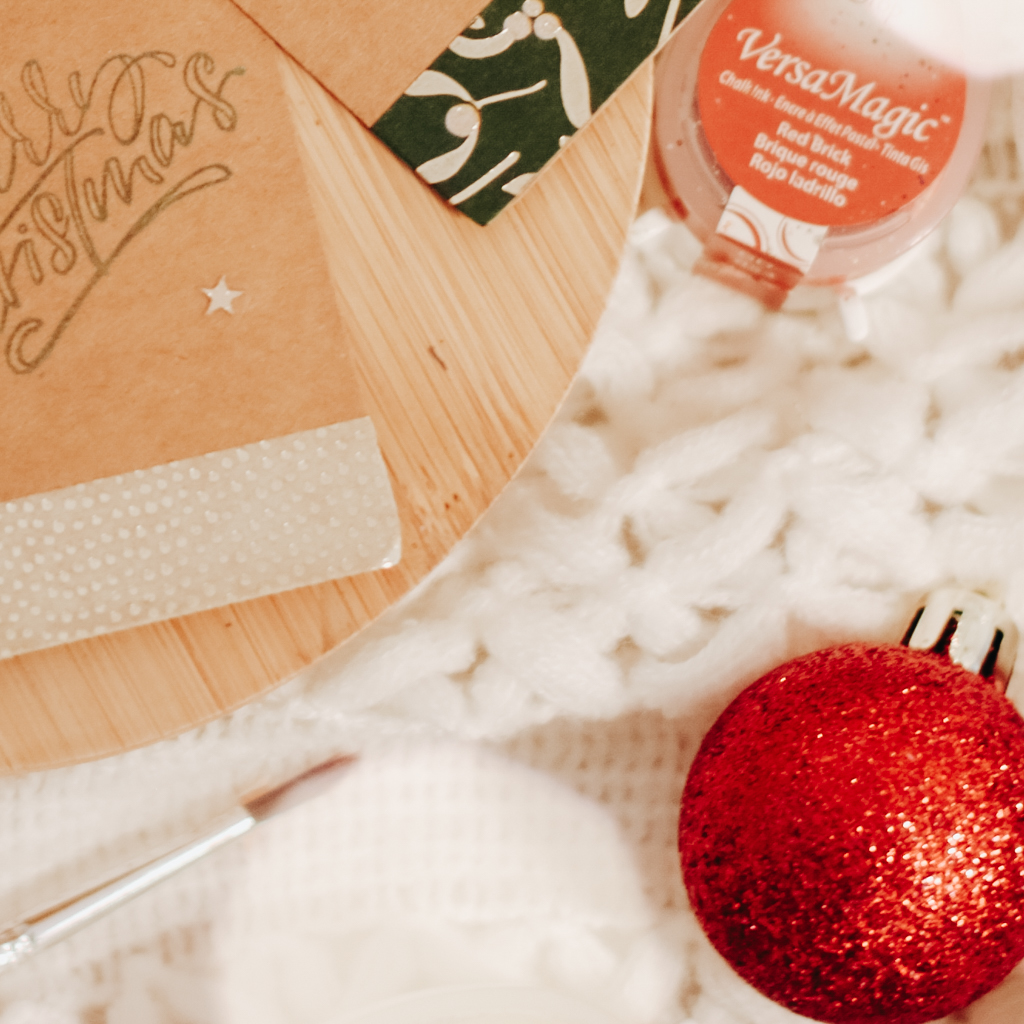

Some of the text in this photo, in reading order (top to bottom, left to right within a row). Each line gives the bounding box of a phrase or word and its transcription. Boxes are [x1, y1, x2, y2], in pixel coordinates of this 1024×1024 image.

[753, 131, 859, 191] Brique rouge
[776, 120, 853, 166] Red Brick
[748, 151, 847, 208] Rojo ladrillo
